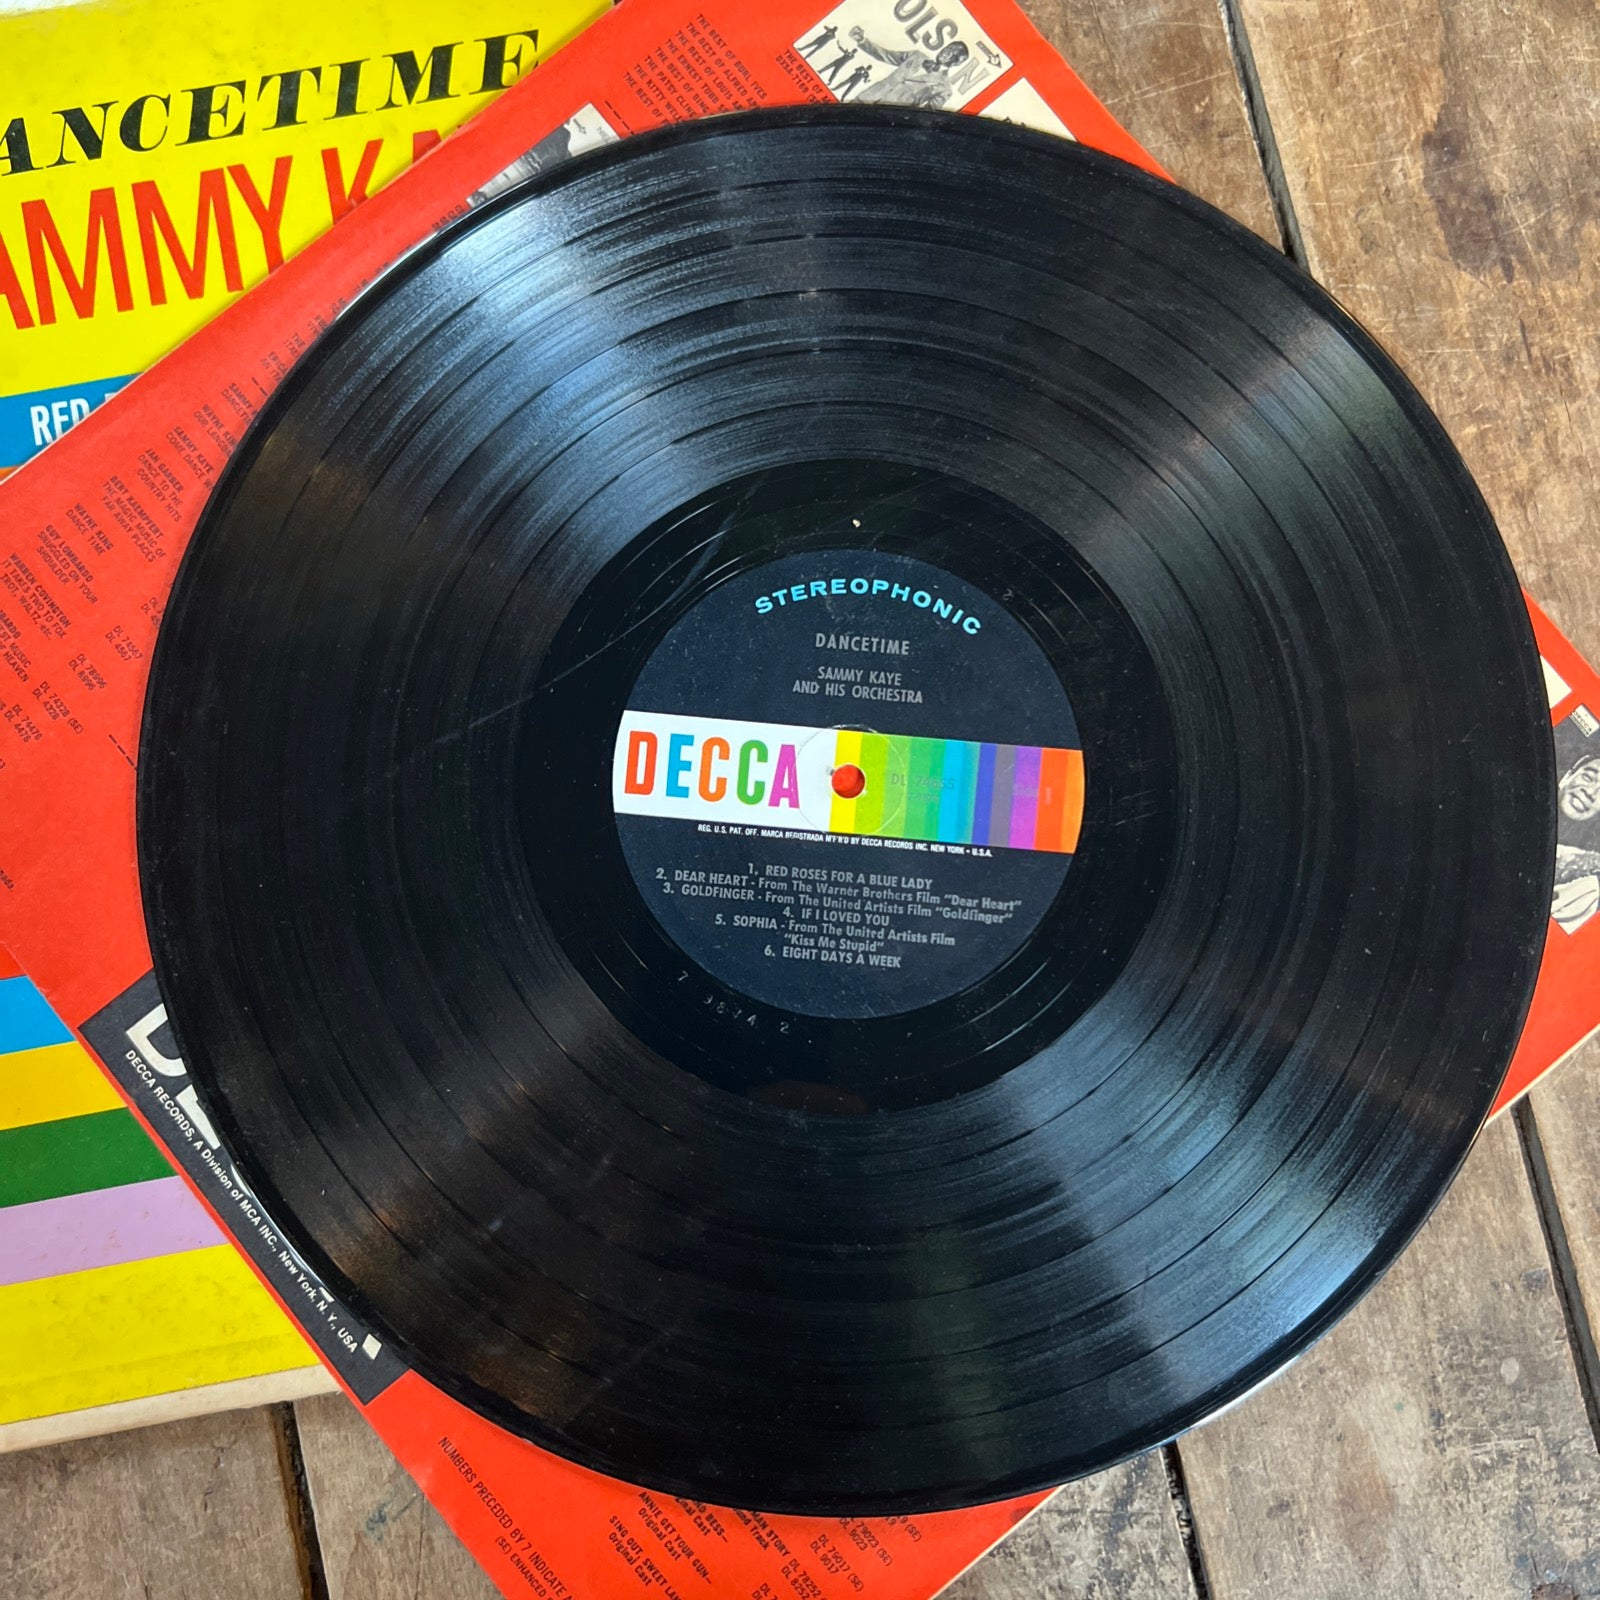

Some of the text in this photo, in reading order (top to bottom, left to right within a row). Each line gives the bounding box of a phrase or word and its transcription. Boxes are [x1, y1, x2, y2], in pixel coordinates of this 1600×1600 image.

[653, 47, 710, 114] THE BEST OF BING
[663, 38, 720, 104] THE ERNEST TUBB
[684, 22, 748, 97] THE BEST OF ALFRED
[695, 13, 768, 99] THE BEST OF BURL IVES
[144, 447, 184, 493] JAN GARBER
[172, 425, 214, 474] SAMMY KAYE
[72, 502, 114, 550] WAYNE KING
[99, 495, 156, 563] FAR AWAY PLACES
[108, 475, 163, 539] BERT KAEMPFERT
[35, 544, 71, 586] SHOULDER
[35, 530, 99, 604] SNUGGLED ON YOUR
[43, 524, 94, 583] GUY LOMBARDO
[7, 552, 72, 628] WARREN COVINGTON
[755, 577, 982, 636] STEREOPHONIC
[7, 642, 32, 669] MUSIC
[815, 633, 910, 655] DANCETIME
[792, 680, 923, 703] AND HIS ORCHESTRA
[817, 666, 902, 686] SAMMY KAYE
[38, 680, 84, 735] DL 74328 (SE)
[624, 730, 800, 809] DECCA
[697, 823, 711, 832] REG.
[714, 825, 727, 833] U.S.
[729, 826, 743, 834] PAT.
[745, 827, 758, 836] OFF.
[761, 829, 783, 838] MARCA
[861, 838, 882, 846] DECCA
[884, 840, 913, 849] RECORDS
[930, 844, 944, 852] NEW
[947, 845, 964, 854] YORK
[655, 868, 668, 880] 2.
[674, 869, 705, 883] DEAR
[708, 872, 748, 887] HEART
[758, 877, 788, 891] From
[792, 880, 813, 893] The
[816, 882, 859, 897] Warner
[862, 886, 913, 902] Brothers
[916, 891, 940, 904] Film
[662, 882, 674, 894] 3.
[681, 884, 754, 901] GOLDFINGER
[764, 891, 794, 905] From
[798, 894, 819, 907] The
[822, 896, 861, 911] United
[864, 900, 904, 914] Artists
[907, 903, 932, 917] Film
[747, 863, 932, 890] 1. RED ROSES FOR A BLUE LADY
[715, 914, 955, 946] 5. SOPHIA From The United Artists Film
[782, 906, 889, 927] 4. IF I LOVED YOU
[764, 945, 901, 968] 6. EIGHT DAYS A WEEK
[818, 936, 836, 949] Me
[124, 1049, 157, 1088] DECCA
[152, 1086, 198, 1141] RECORDS,
[193, 1138, 205, 1150] A
[200, 1148, 235, 1189] Division
[230, 1186, 244, 1201] of
[238, 1198, 262, 1226] MCA
[257, 1224, 282, 1252] INC.,
[278, 1250, 300, 1274] New
[294, 1273, 320, 1302] York,
[316, 1299, 330, 1314] N.
[336, 1326, 359, 1352] USA
[436, 1436, 567, 1596] NUMBERS PRECEDED BY 7 INDICATE
[636, 1507, 682, 1561] Original Cast
[638, 1490, 663, 1519] ANNIE
[659, 1517, 676, 1535] GET
[672, 1534, 694, 1558] YOUR
[749, 1526, 770, 1549] Track
[494, 1534, 547, 1598] (SE) ENHANCED
[606, 1532, 653, 1587] Original Cast
[608, 1514, 668, 1587] SING OUT, SWEET
[765, 1529, 790, 1557] STORY
[787, 1558, 801, 1572] DL
[816, 1533, 830, 1547] DL
[845, 1572, 865, 1593] (SE)
[779, 1565, 810, 1600] DL 8252
